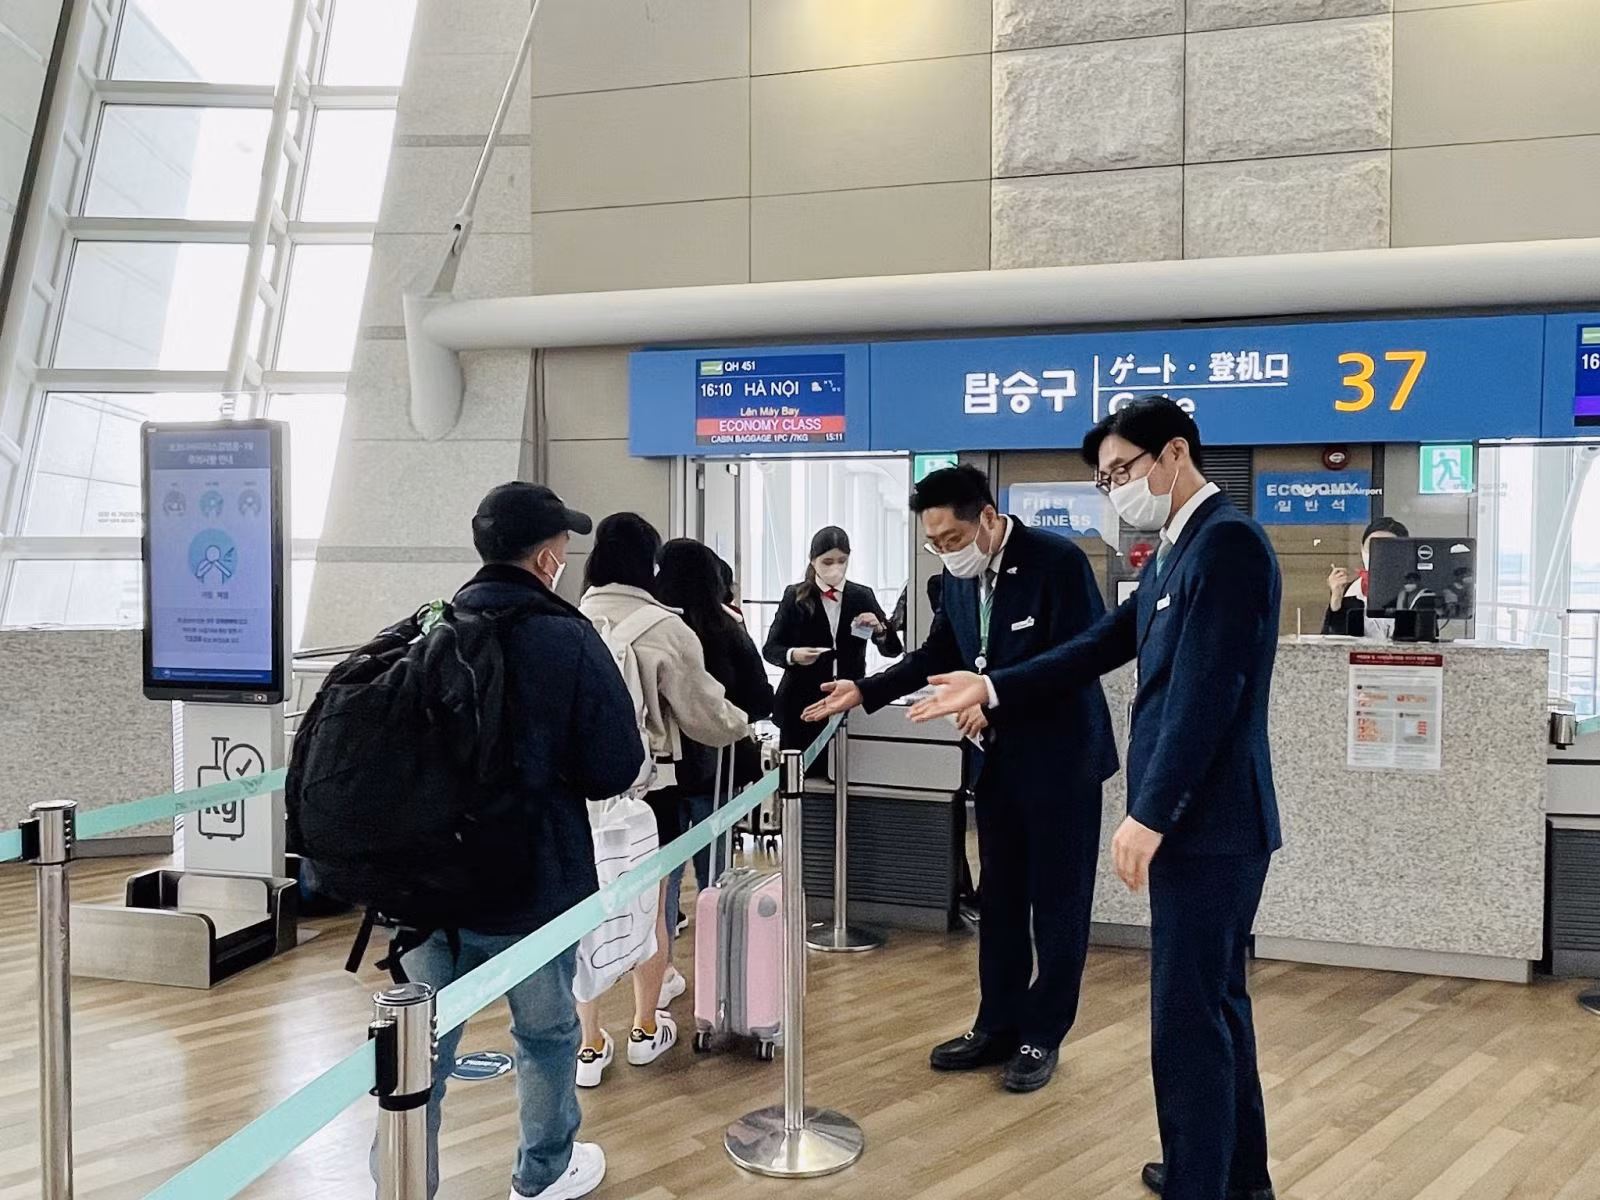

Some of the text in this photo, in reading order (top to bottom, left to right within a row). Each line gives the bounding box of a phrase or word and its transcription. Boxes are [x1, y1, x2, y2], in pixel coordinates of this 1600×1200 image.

[724, 361, 756, 372] QH 451
[1109, 350, 1288, 384] ゲート 登机口
[701, 379, 799, 398] 16:10 HÀ NỘI
[1335, 351, 1427, 411] 37
[964, 370, 1076, 414] 탑승구
[782, 406, 800, 417] Bay
[1108, 392, 1196, 419] Ge
[720, 418, 822, 432] ECONOMY CLASS
[711, 435, 734, 443] CABIN
[735, 434, 772, 443] BAGGAGE
[1023, 497, 1077, 510] FIRST
